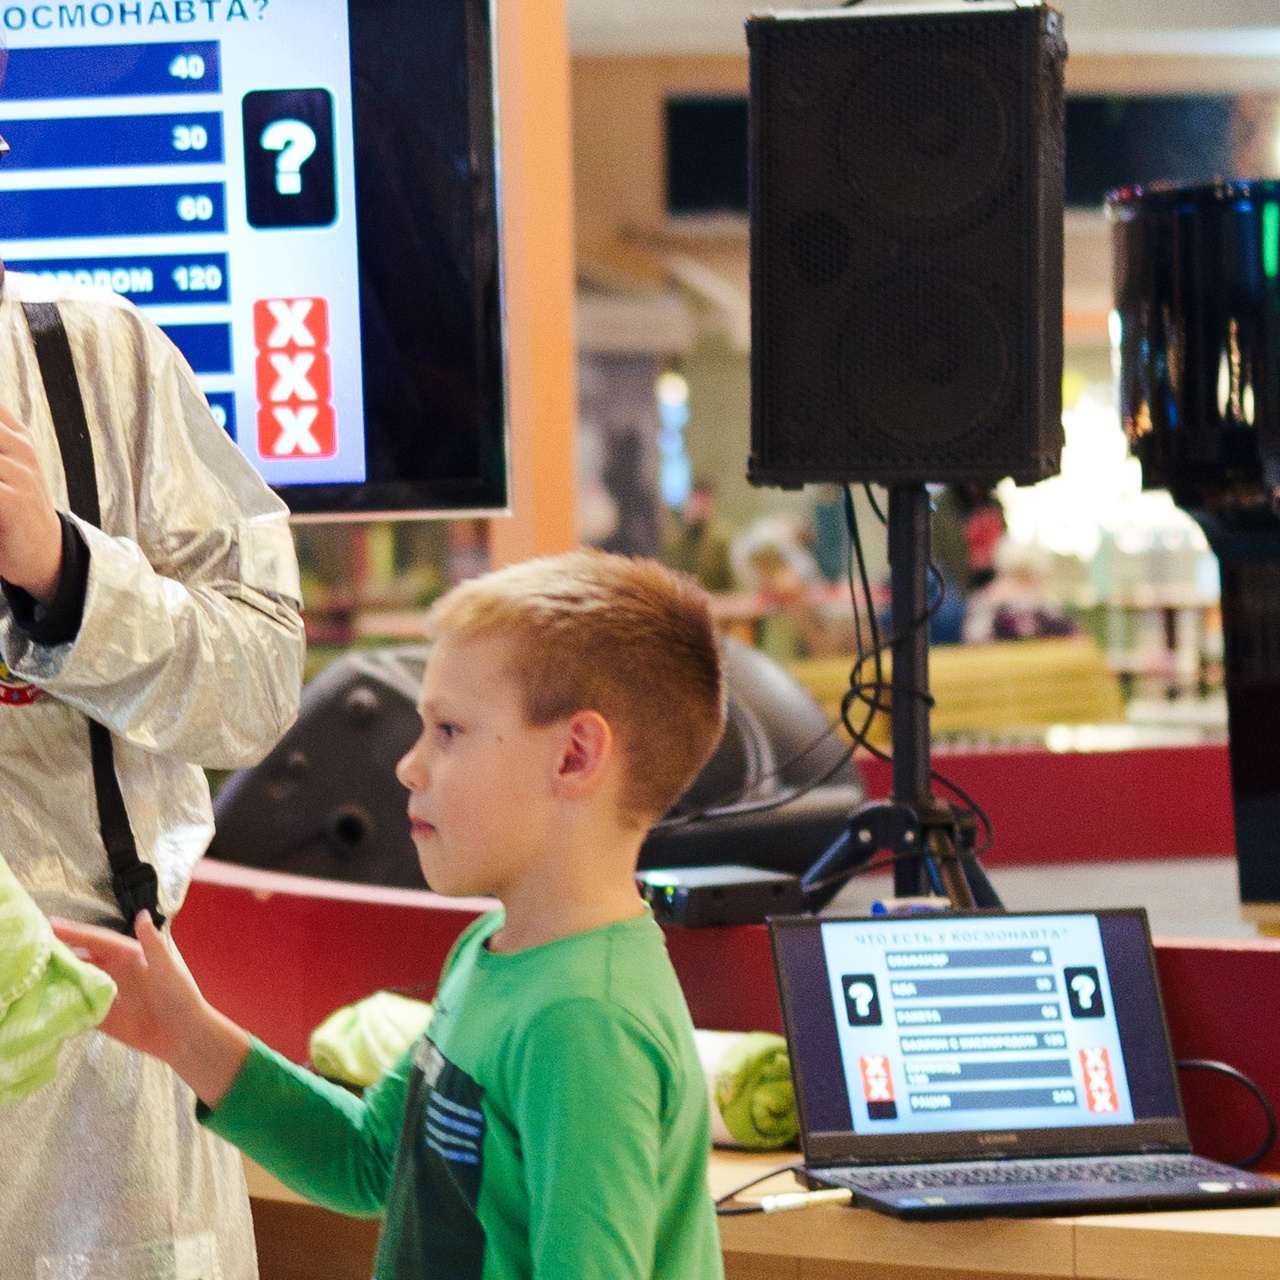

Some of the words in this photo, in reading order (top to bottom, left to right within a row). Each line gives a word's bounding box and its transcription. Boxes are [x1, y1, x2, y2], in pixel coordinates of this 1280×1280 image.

[170, 54, 206, 80] 40
[172, 125, 208, 151] 30
[177, 195, 214, 221] 60
[173, 264, 222, 292] 120
